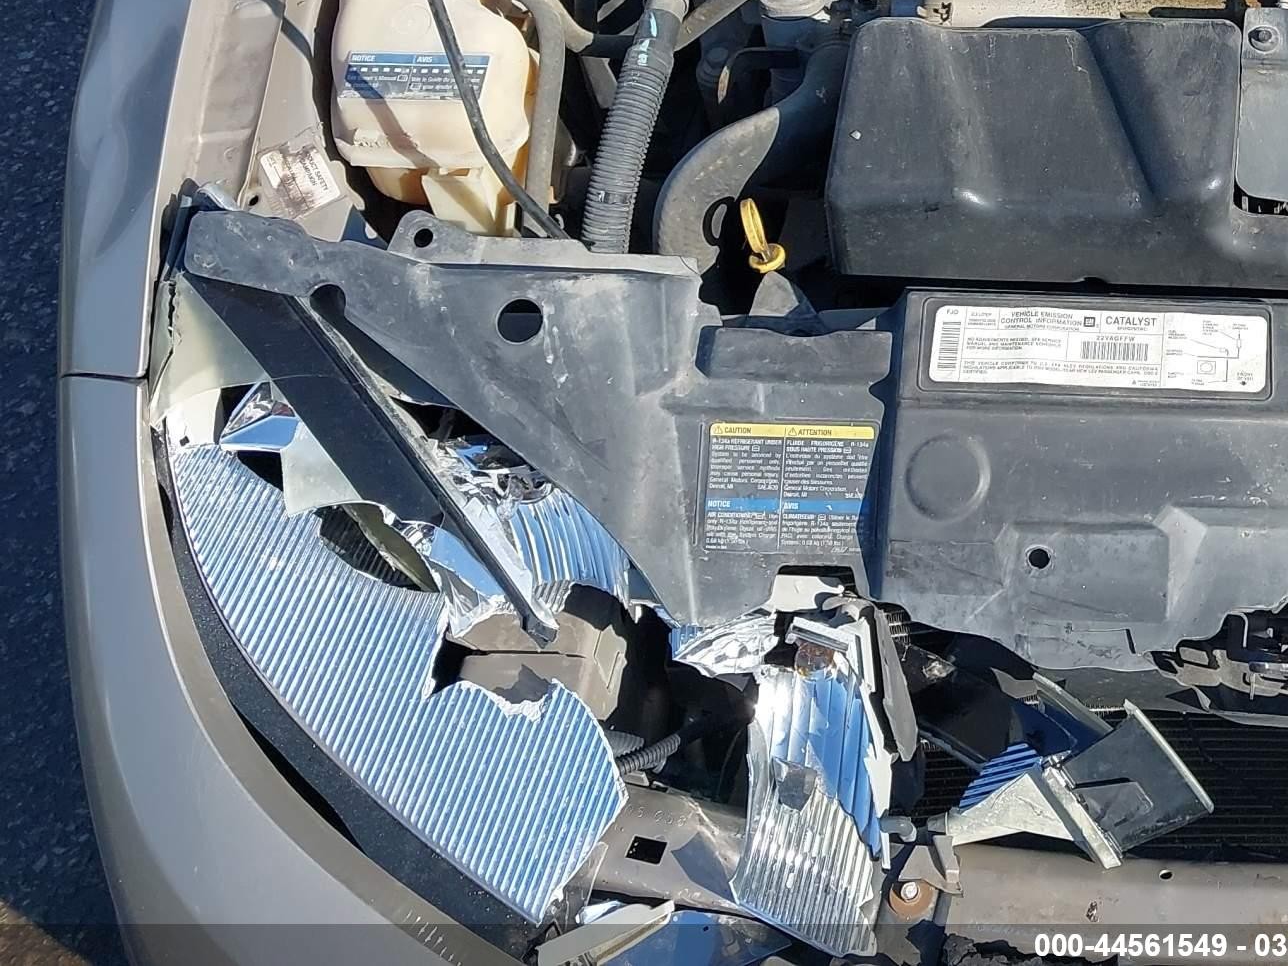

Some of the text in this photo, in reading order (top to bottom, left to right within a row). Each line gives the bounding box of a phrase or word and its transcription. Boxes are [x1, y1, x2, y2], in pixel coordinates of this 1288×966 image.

[1041, 311, 1073, 319] EMISSION
[1035, 318, 1082, 326] INFORMATION
[1105, 316, 1158, 327] CATALYST
[783, 502, 799, 510] AVIS
